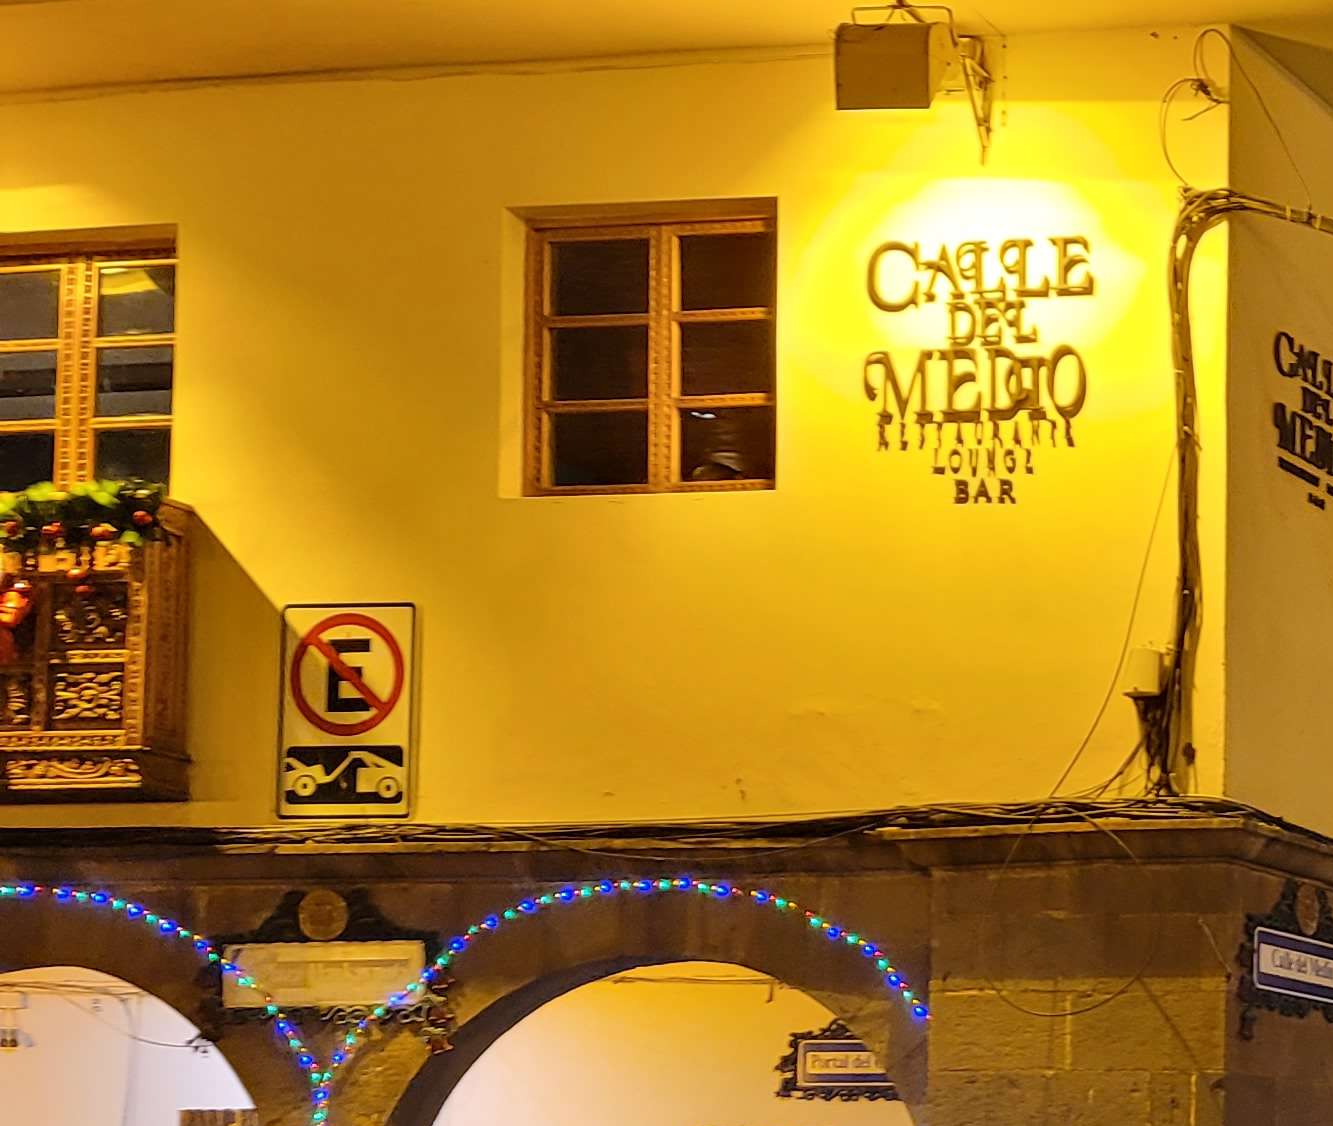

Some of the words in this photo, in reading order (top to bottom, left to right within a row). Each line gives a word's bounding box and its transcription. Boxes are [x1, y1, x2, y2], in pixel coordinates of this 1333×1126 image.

[867, 236, 1094, 313] CALLE
[947, 299, 1037, 347] DEL
[864, 345, 1087, 424] MEDIO
[952, 478, 1017, 505] BAR
[328, 639, 371, 713] E
